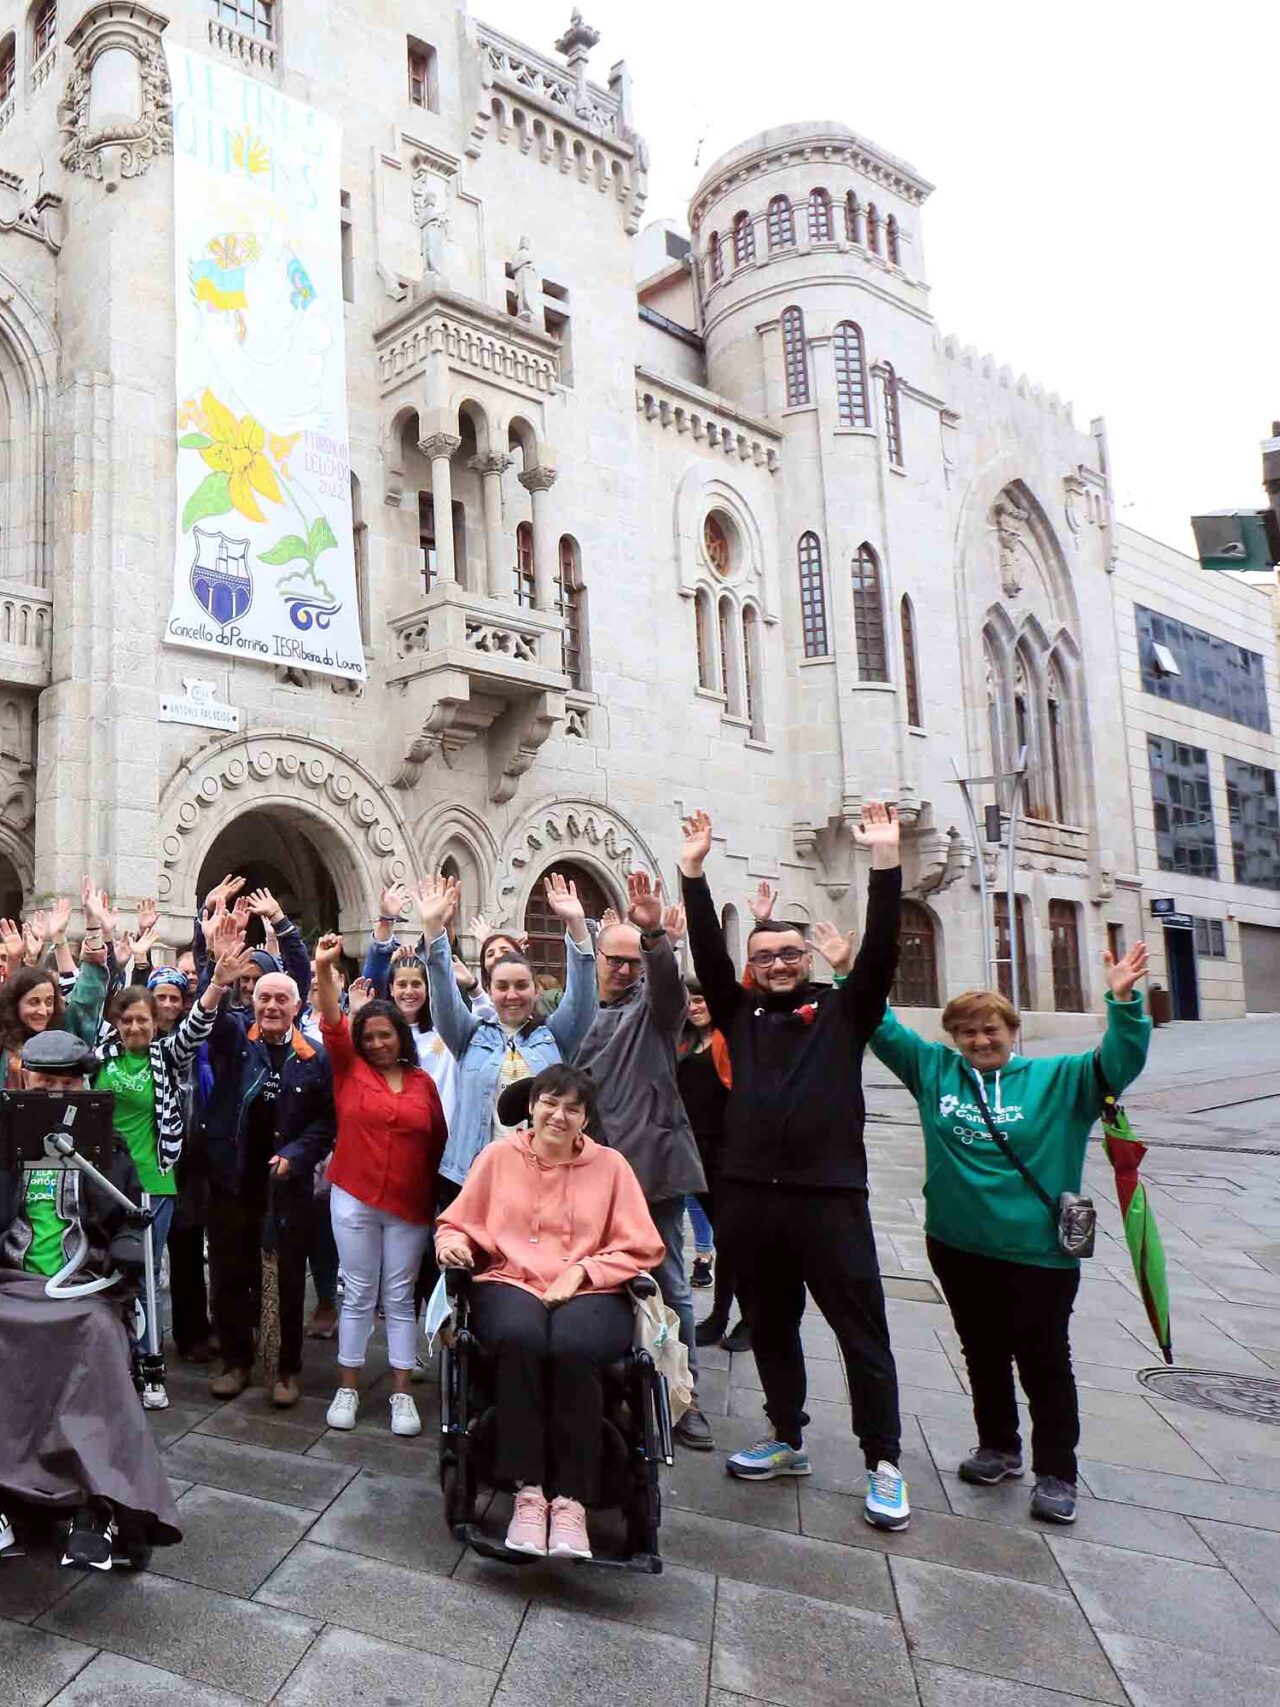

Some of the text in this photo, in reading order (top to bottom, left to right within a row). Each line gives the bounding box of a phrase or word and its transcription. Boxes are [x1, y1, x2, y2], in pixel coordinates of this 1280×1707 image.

[170, 618, 213, 641] Concello
[216, 627, 229, 645] do
[336, 650, 362, 672] Louro
[953, 1126, 1008, 1145] agaea
